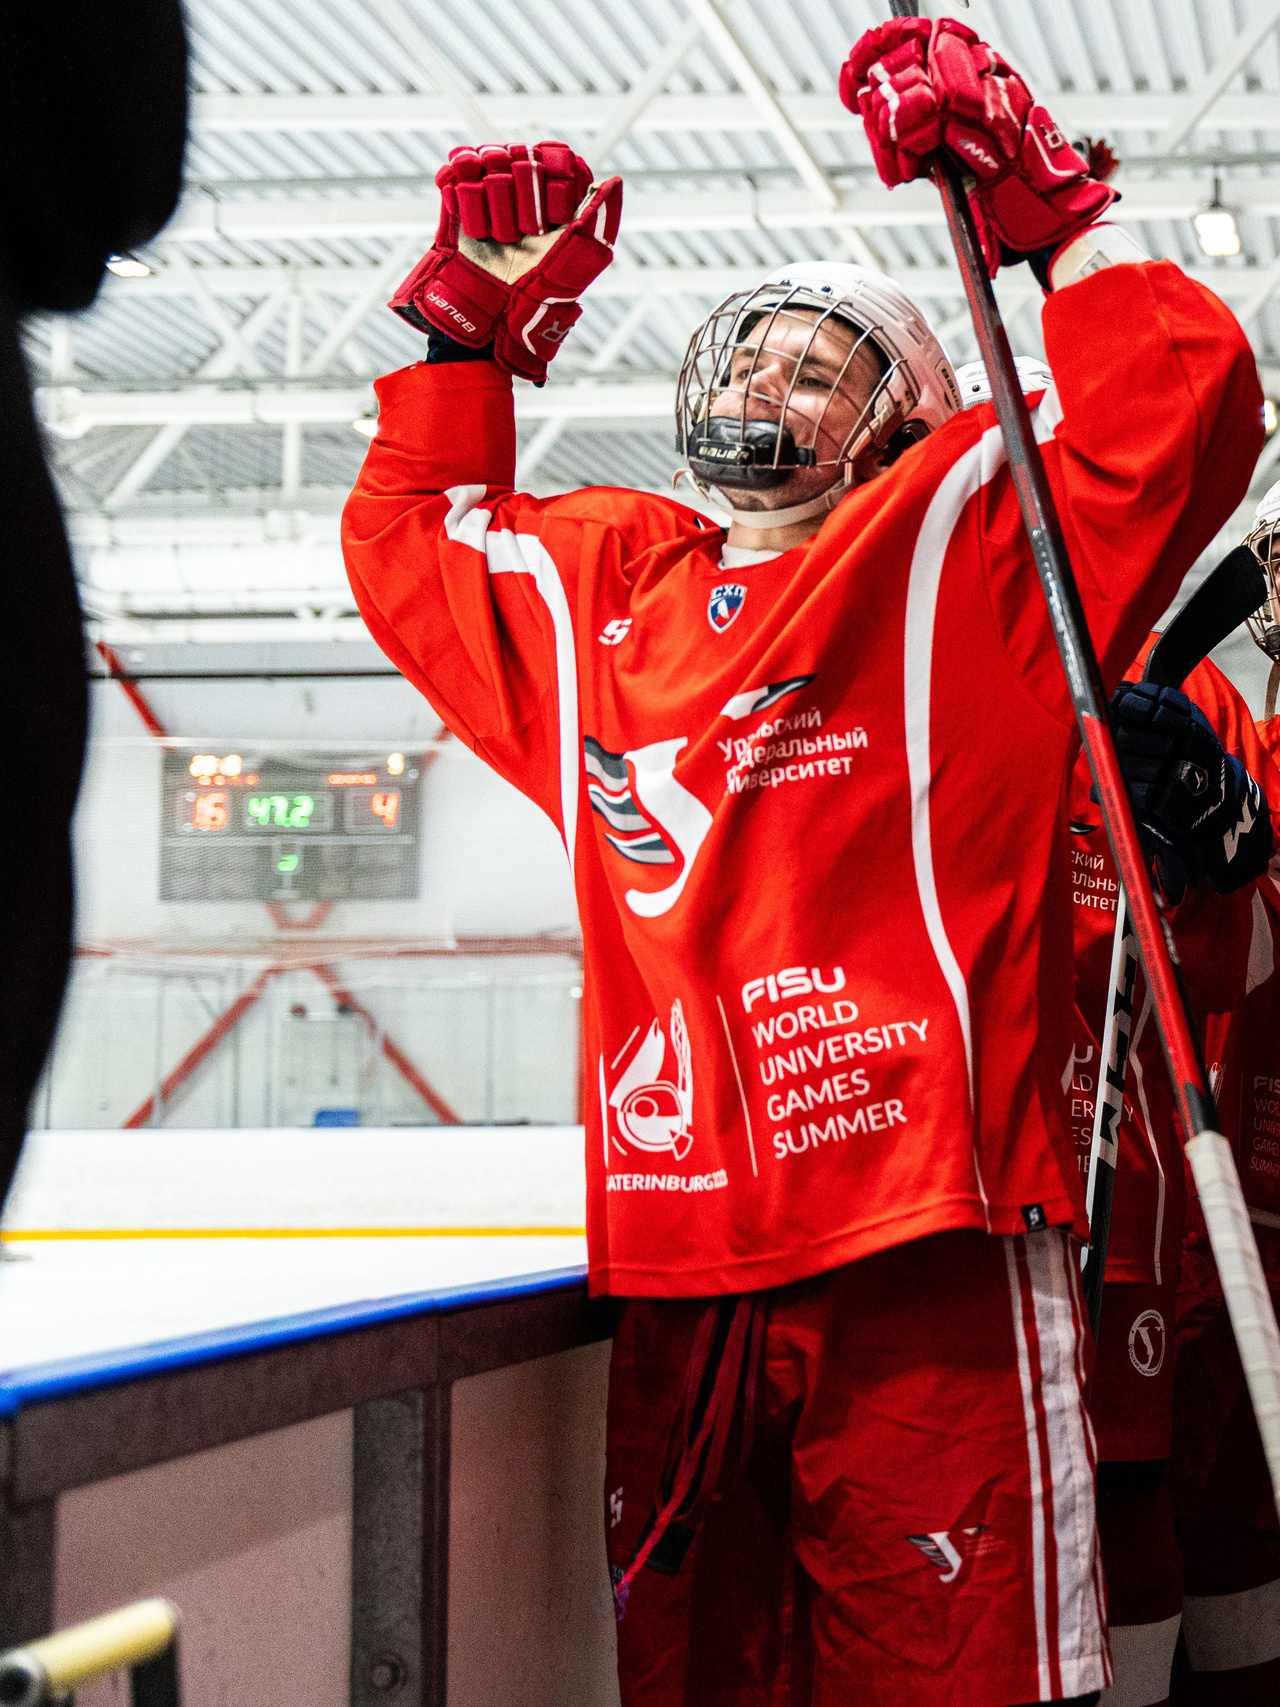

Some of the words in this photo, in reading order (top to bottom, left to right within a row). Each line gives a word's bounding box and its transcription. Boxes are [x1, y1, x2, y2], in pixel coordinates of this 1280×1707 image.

[940, 367, 961, 412] BAUE
[716, 706, 822, 762] Урьский
[371, 792, 400, 828] 4
[742, 966, 846, 1014] FISU
[752, 1000, 859, 1049] WORLD
[759, 1018, 929, 1086] UNIVERSITY
[766, 1068, 871, 1122] GAMES
[772, 1098, 908, 1160] SUMMER
